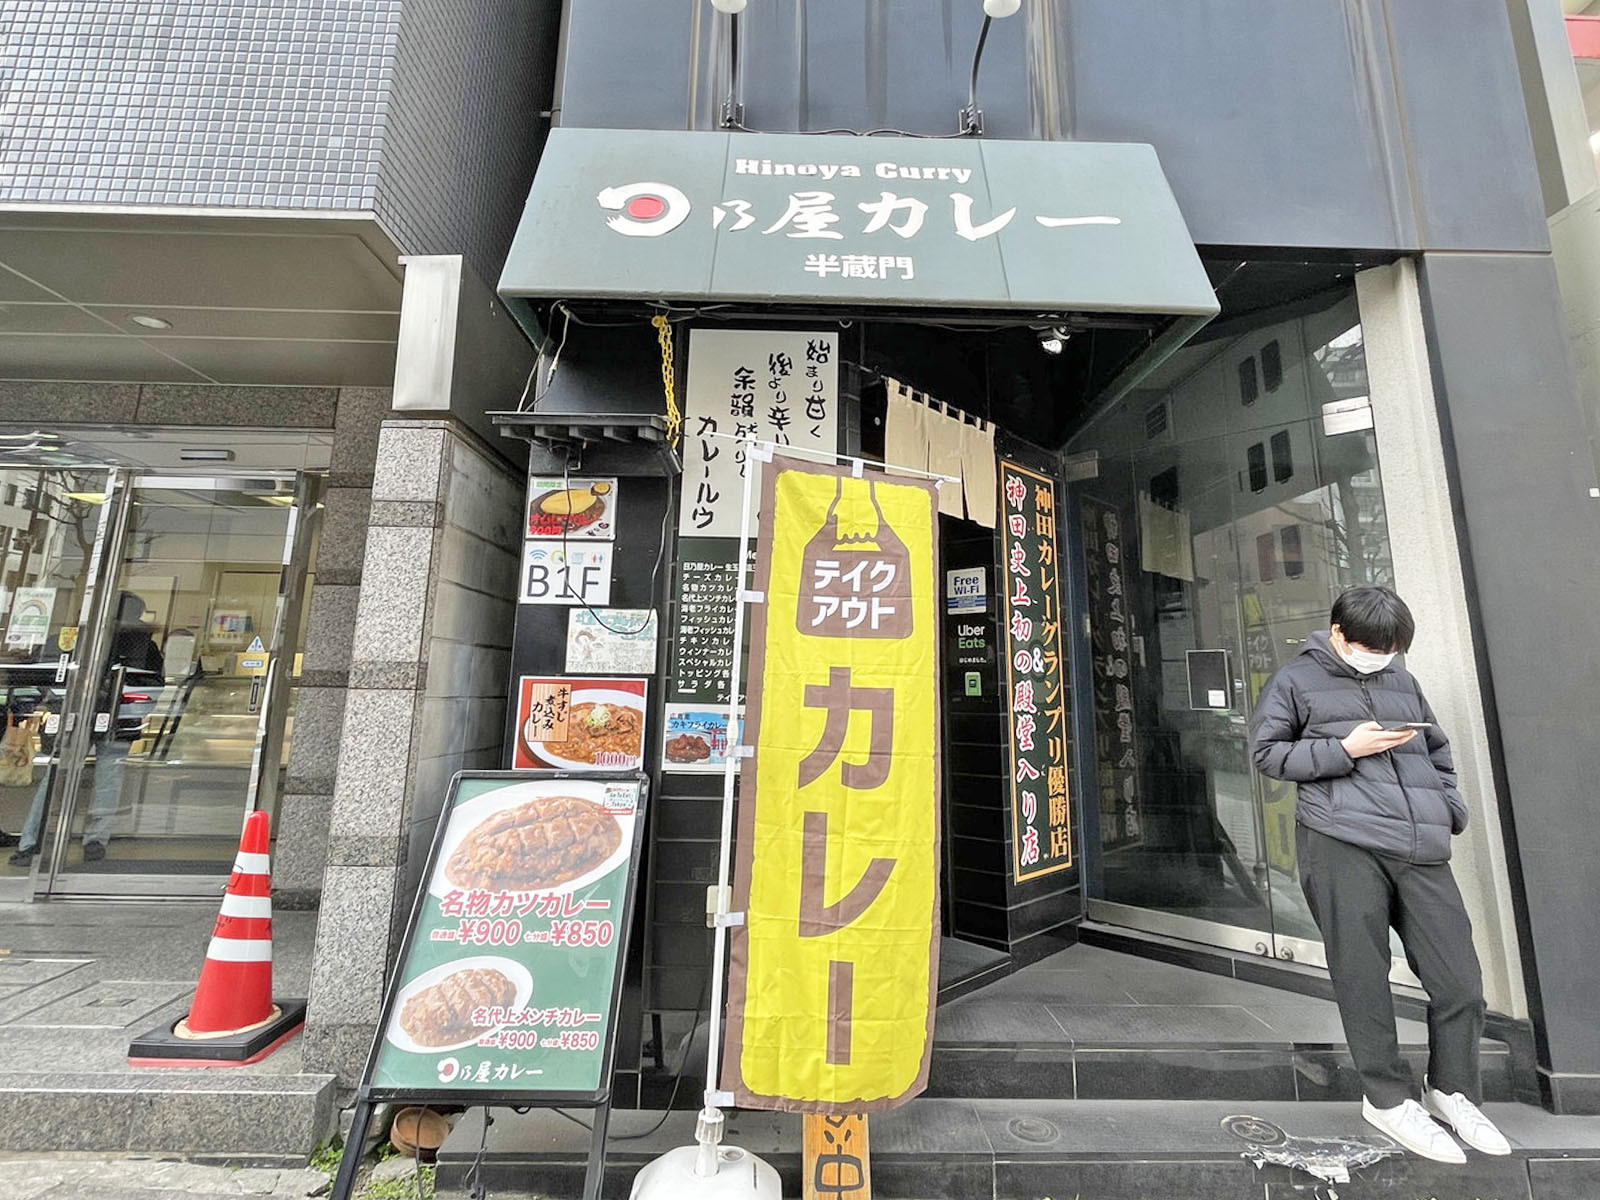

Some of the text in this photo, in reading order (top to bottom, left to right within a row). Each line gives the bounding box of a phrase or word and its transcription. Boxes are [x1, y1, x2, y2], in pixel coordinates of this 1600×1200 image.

[735, 158, 972, 184] Hinoya Curry
[804, 253, 915, 280] 半蔵門
[692, 415, 720, 529] カレールウ
[527, 564, 601, 599] B1F
[682, 573, 739, 581] チーズカレ
[814, 559, 896, 592] テイク
[953, 576, 980, 586] Free
[681, 583, 738, 592] 名物カツカレ
[681, 593, 737, 602] 名代上メンチカレ
[680, 604, 737, 613] 海老フライカレ
[811, 595, 896, 630] アウト
[680, 615, 737, 623] フィッシュカレ
[679, 625, 735, 634] 海老フィッシュカレ
[957, 624, 986, 637] Uber
[679, 637, 734, 645] チキンカレ
[958, 637, 986, 648] Eats
[678, 647, 733, 656] ウィンナーカレ
[678, 658, 733, 666] スペシャルカレ
[1006, 474, 1040, 866] 神田史上初の殿堂入り店
[1034, 484, 1069, 859] 神田カレーグランプリ優勝店
[532, 701, 544, 738] カレー
[798, 667, 897, 1065] カレー
[440, 889, 611, 917] 名物カツカレー
[459, 919, 521, 945] ¥900
[551, 921, 613, 946] ¥850
[472, 1008, 601, 1026] 名代上メンチカレー
[498, 1031, 536, 1048] ¥900
[560, 1032, 598, 1049] ¥850
